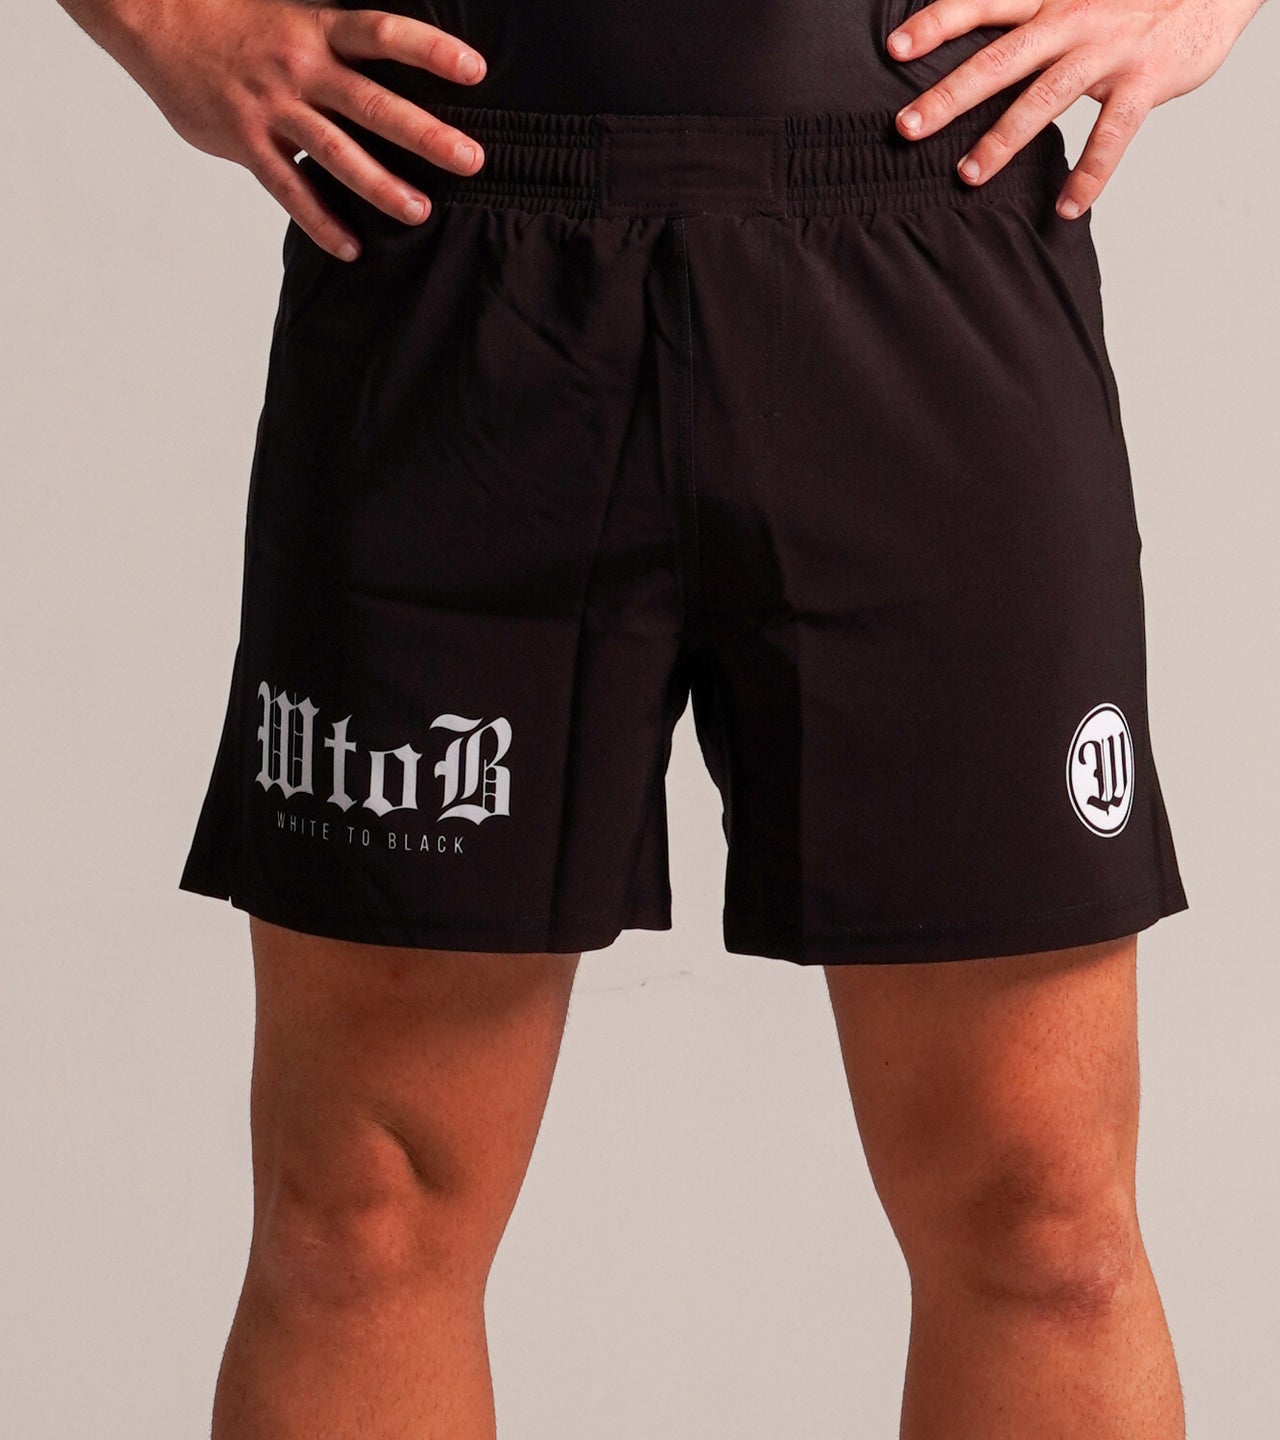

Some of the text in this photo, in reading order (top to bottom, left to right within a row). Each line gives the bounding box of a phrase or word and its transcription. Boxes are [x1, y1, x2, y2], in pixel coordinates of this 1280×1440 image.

[276, 810, 465, 854] WHITE TO BLACK
